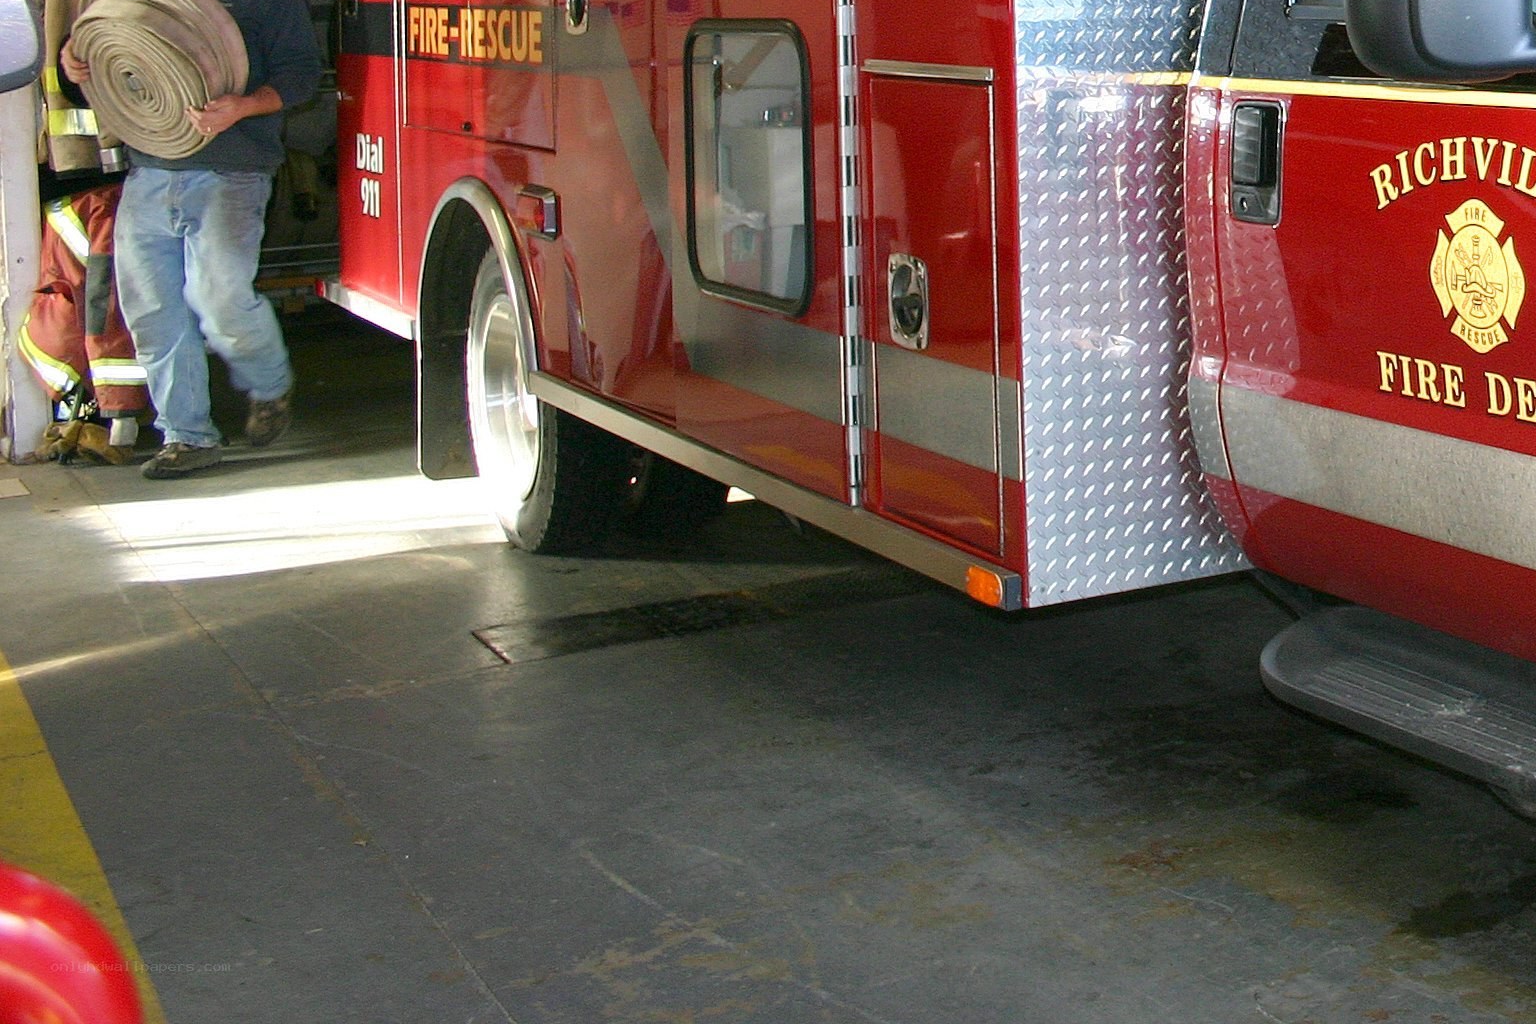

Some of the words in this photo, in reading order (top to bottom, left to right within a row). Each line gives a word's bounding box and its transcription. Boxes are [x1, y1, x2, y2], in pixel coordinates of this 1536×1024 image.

[409, 6, 543, 64] FIRE-RESCUE
[356, 132, 384, 174] Dial
[360, 177, 380, 218] 911
[1464, 207, 1487, 223] FIRE
[1376, 350, 1466, 408] FIRE
